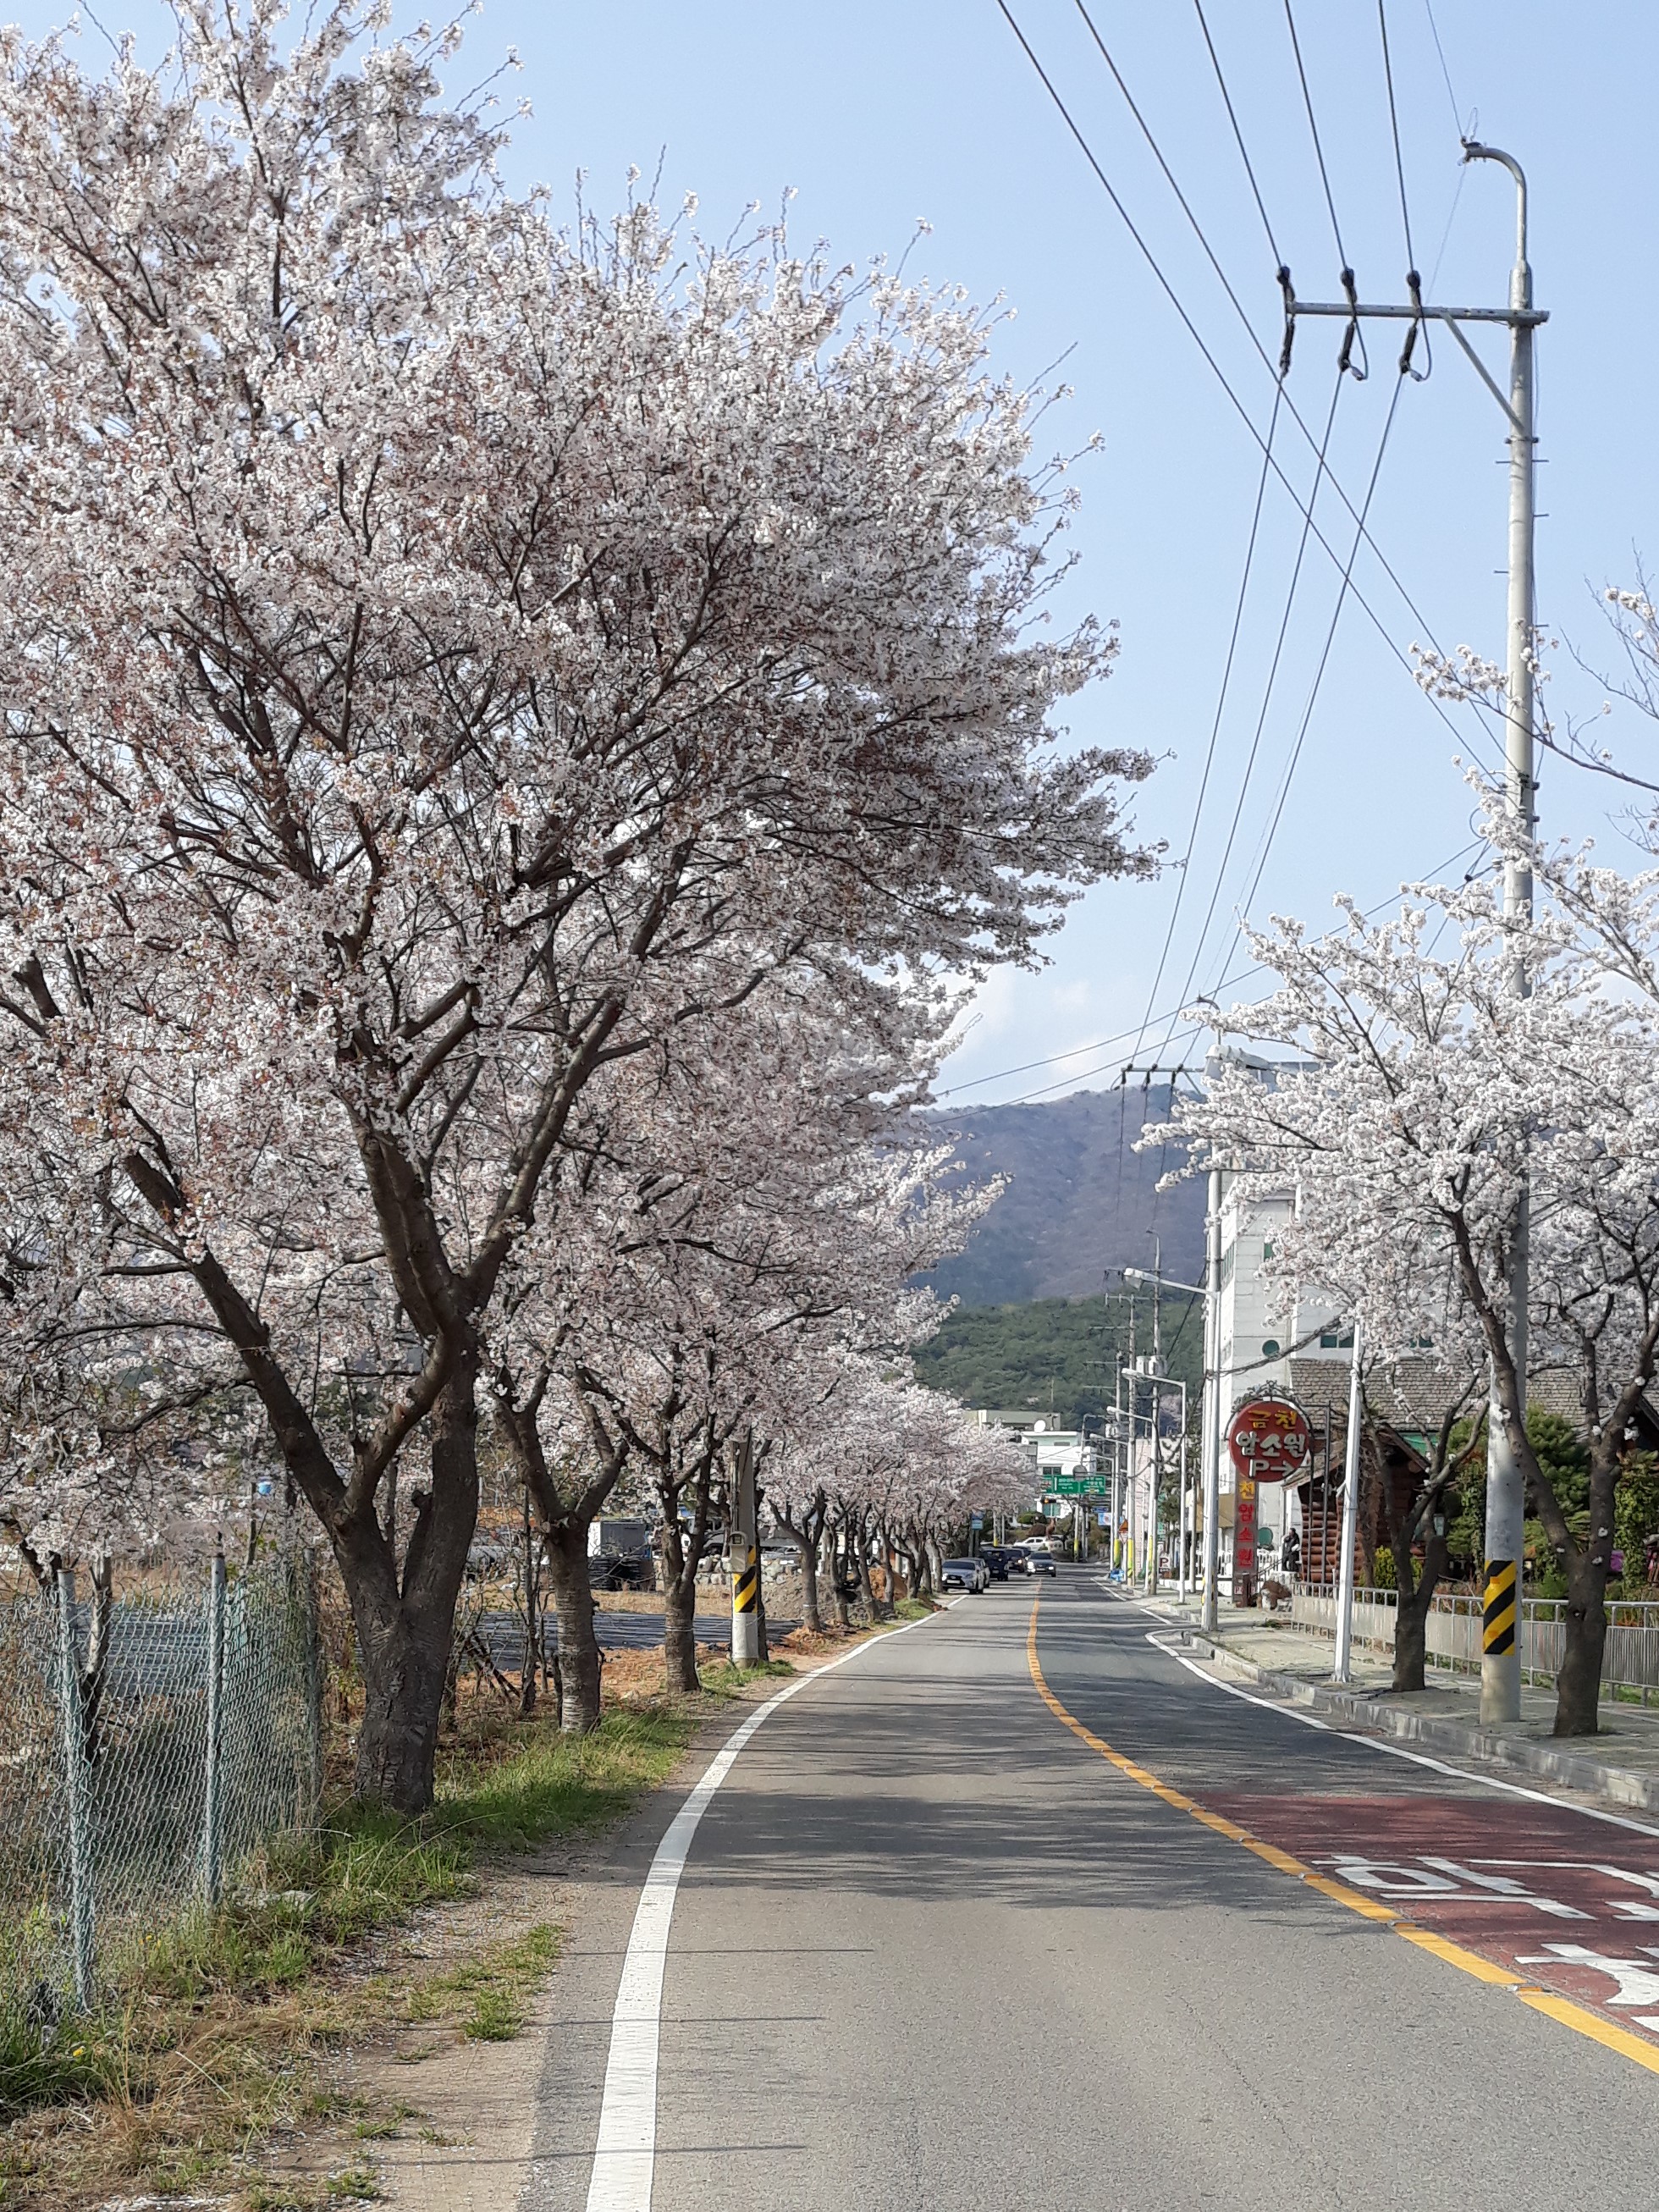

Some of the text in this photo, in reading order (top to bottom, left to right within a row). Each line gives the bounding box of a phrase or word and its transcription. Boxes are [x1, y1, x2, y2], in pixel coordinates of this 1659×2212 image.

[1248, 1409, 1297, 1430] 금천
[1236, 1431, 1305, 1458] 암소원
[1248, 1459, 1270, 1477] P
